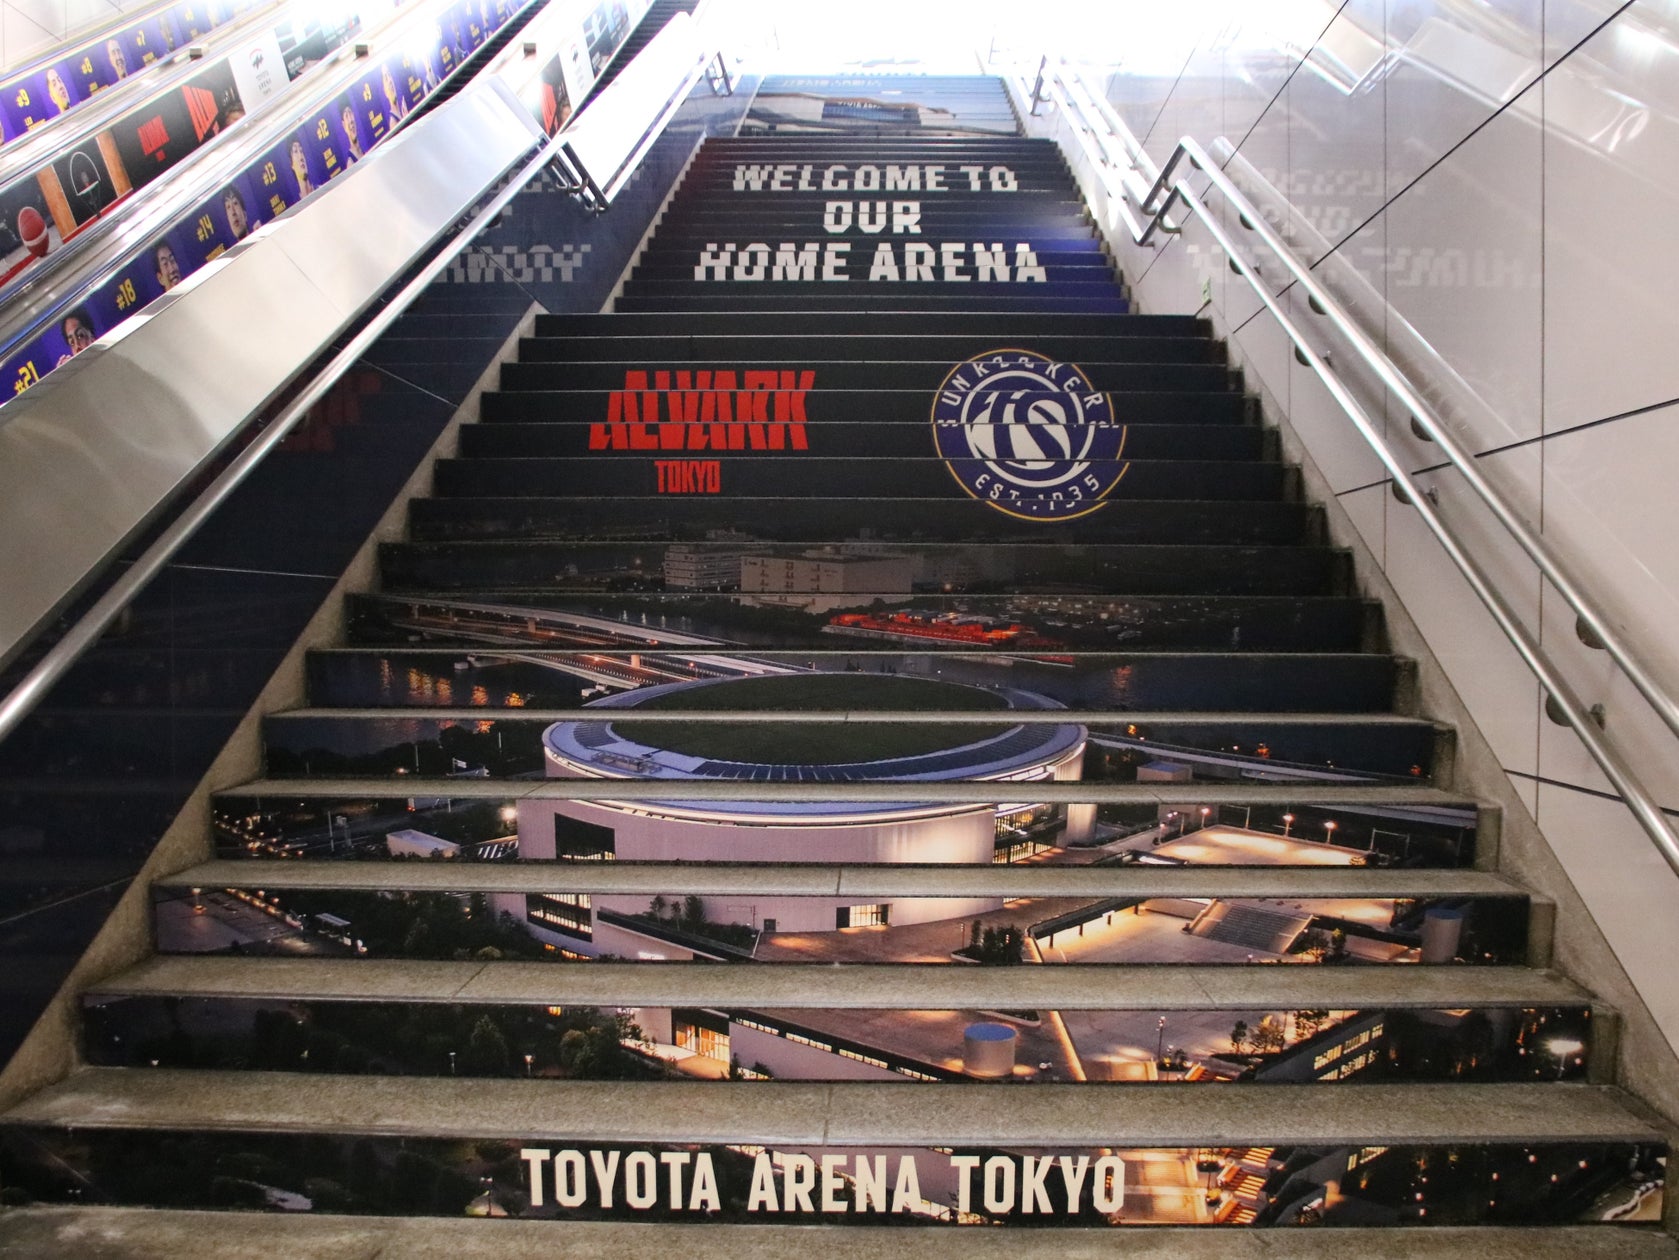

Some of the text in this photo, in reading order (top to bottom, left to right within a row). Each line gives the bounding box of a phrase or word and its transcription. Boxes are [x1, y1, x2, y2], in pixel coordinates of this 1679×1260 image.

[733, 164, 1018, 192] WELCOME TO
[196, 213, 214, 242] #14
[823, 201, 922, 234] OUR
[694, 243, 1047, 283] HOME ARENA
[116, 278, 136, 311] #18
[14, 360, 40, 396] #21
[588, 370, 816, 450] ALVARK
[654, 460, 721, 493] TOKYO
[521, 1148, 1126, 1214] TOYOTA ARENA TOKYO
